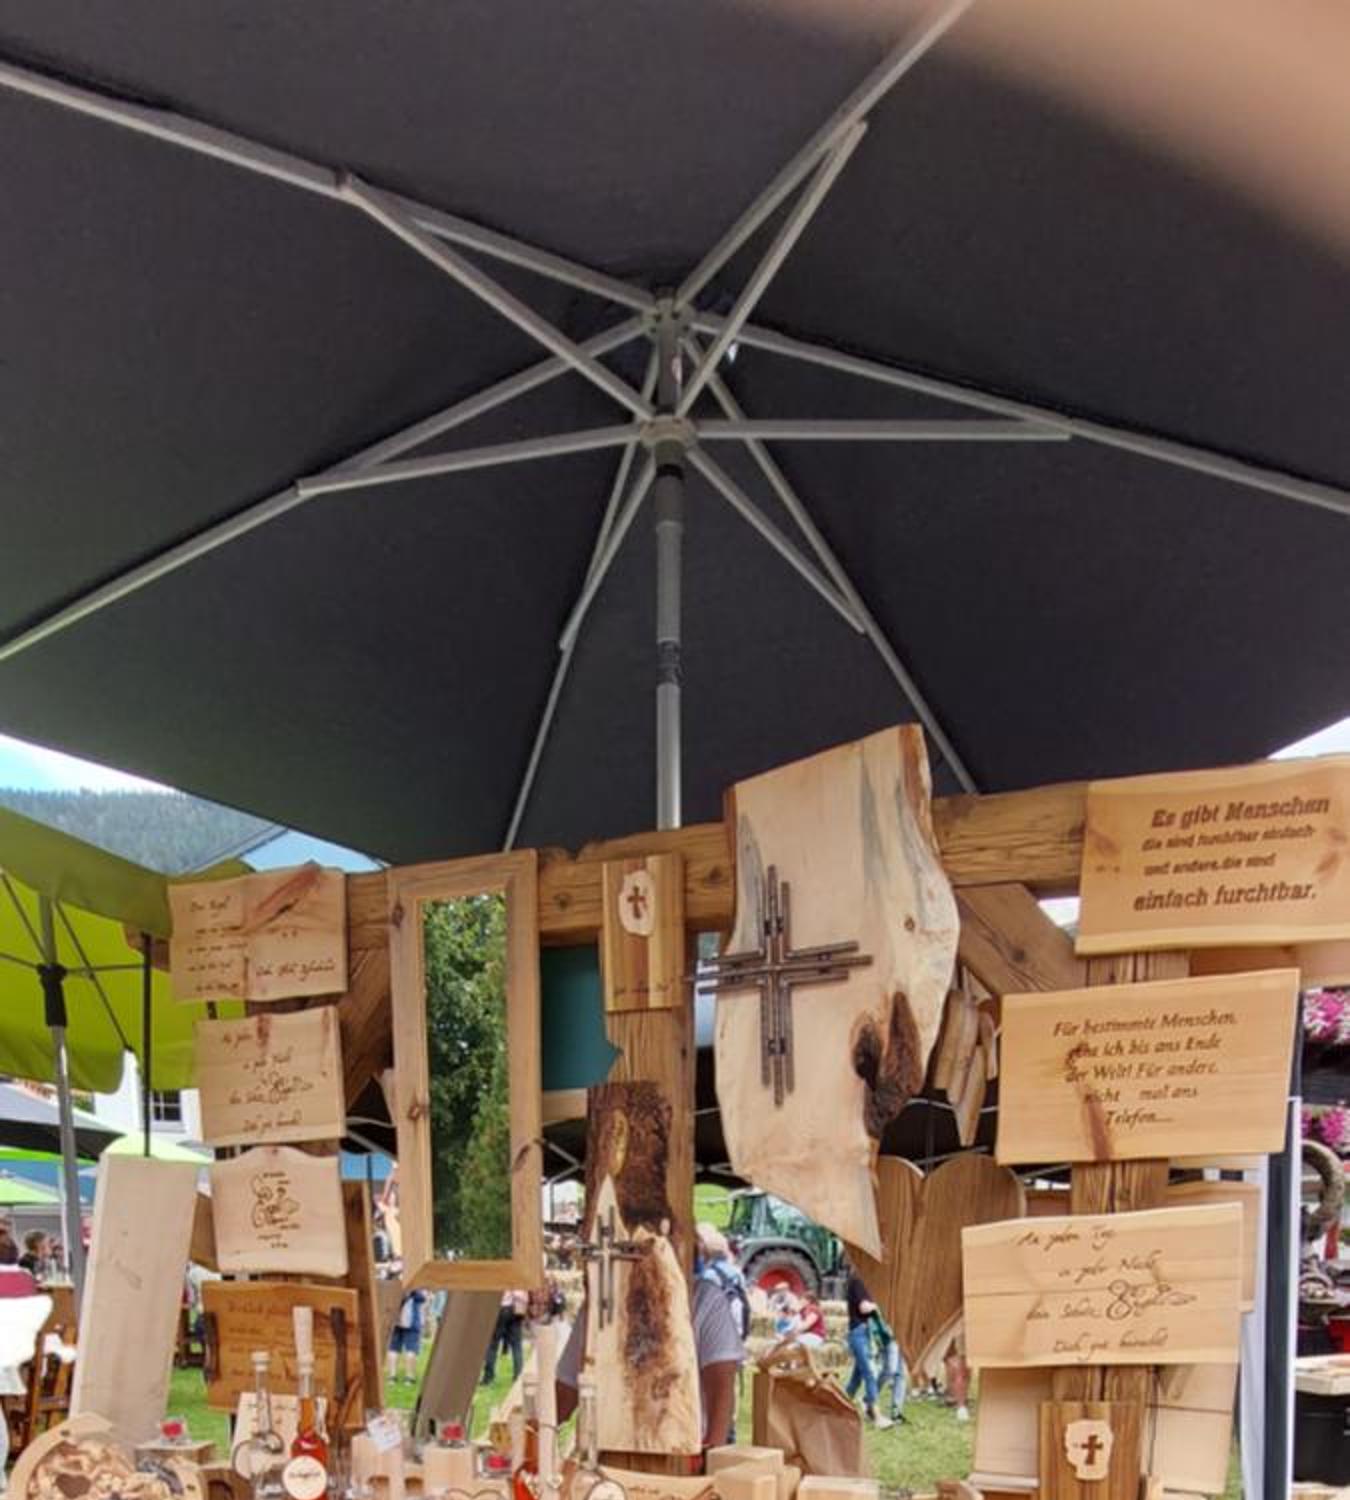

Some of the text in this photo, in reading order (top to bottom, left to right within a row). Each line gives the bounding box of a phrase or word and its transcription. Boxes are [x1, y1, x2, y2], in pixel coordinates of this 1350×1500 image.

[1152, 797, 1330, 829] Es gibt Menschen
[1134, 889, 1207, 911] einfach
